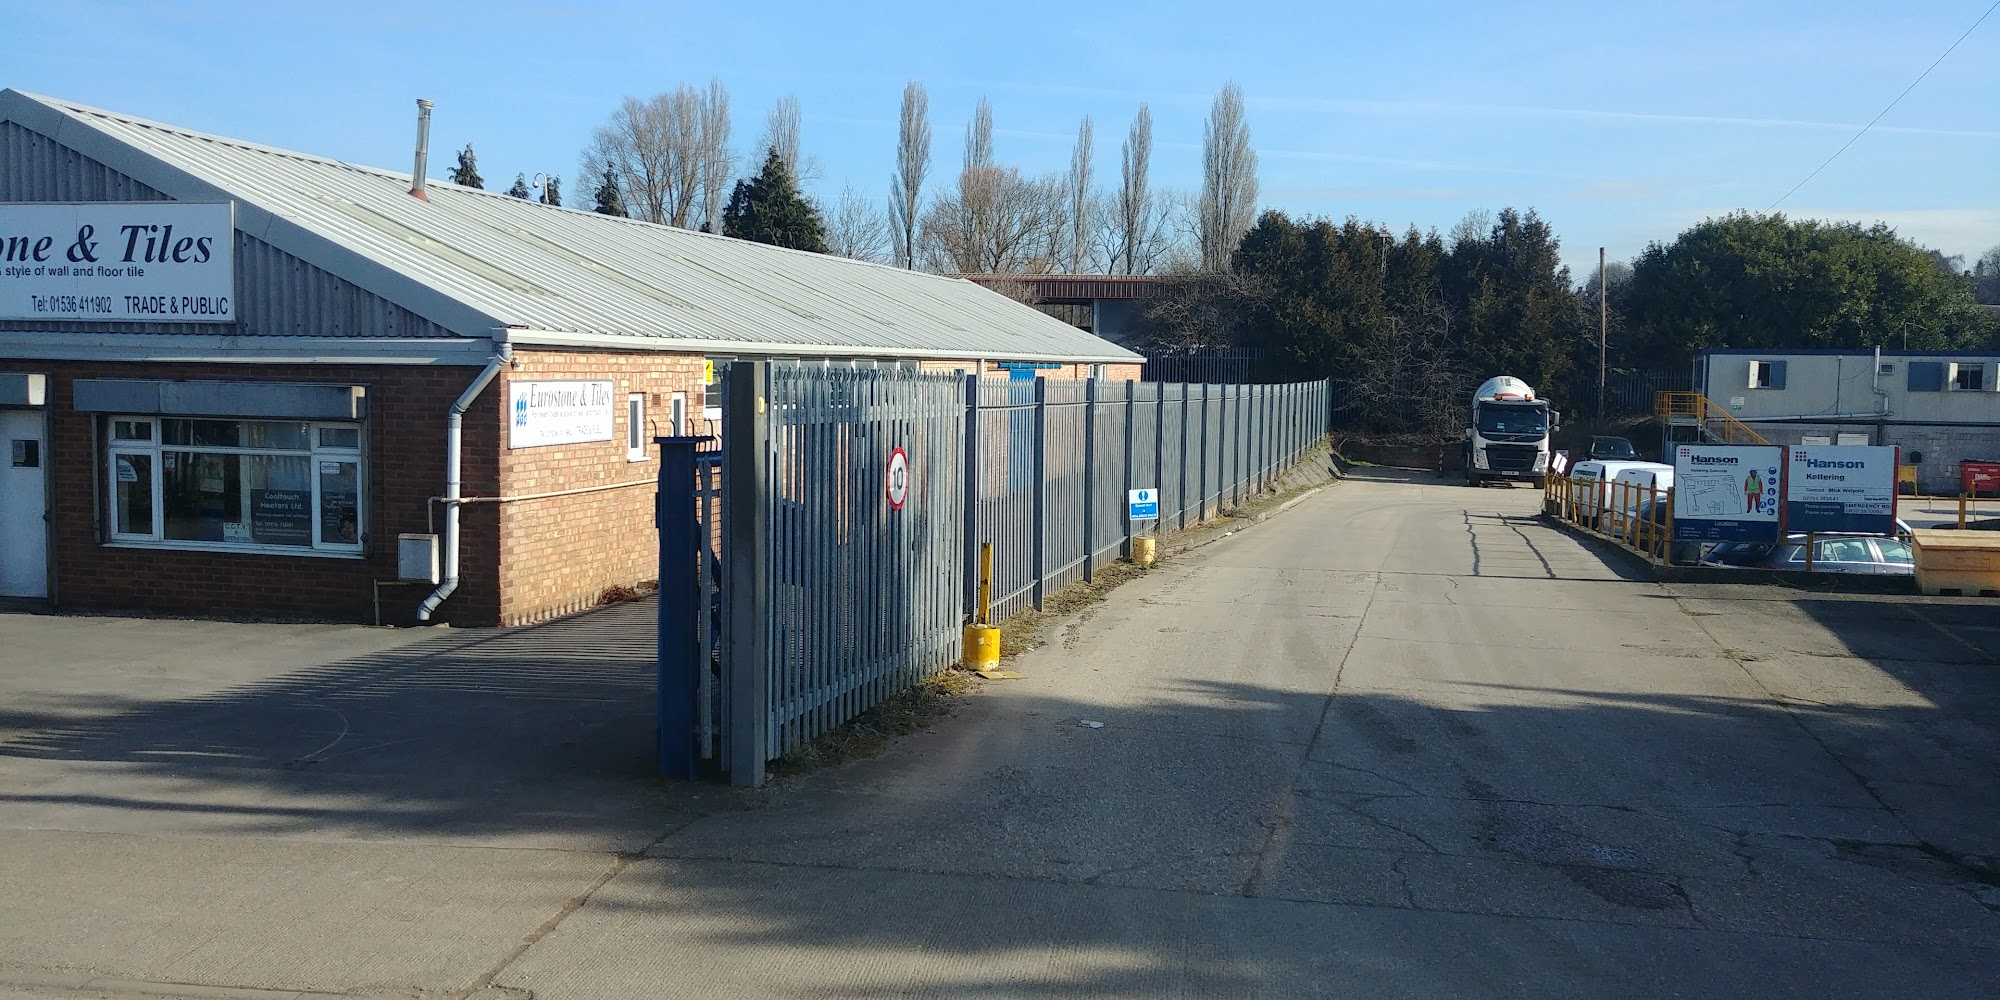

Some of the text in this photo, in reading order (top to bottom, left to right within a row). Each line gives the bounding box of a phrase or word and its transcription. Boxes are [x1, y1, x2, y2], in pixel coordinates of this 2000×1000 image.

[66, 224, 99, 263] &
[119, 224, 212, 263] Tiles
[6, 266, 31, 279] style
[35, 266, 45, 277] of
[48, 267, 69, 277] wall
[73, 267, 94, 277] and
[97, 266, 123, 277] floor
[127, 267, 145, 277] tile
[31, 296, 228, 315] Tel: 01536 411902 TRADE & PUBLIC
[530, 383, 610, 408] Eurostone & Tiles
[1691, 455, 1738, 463] Hanson
[1807, 459, 1864, 469] Hanson
[893, 467, 903, 490] 10
[1806, 473, 1845, 482] Kettering
[260, 501, 288, 509] Heaters
